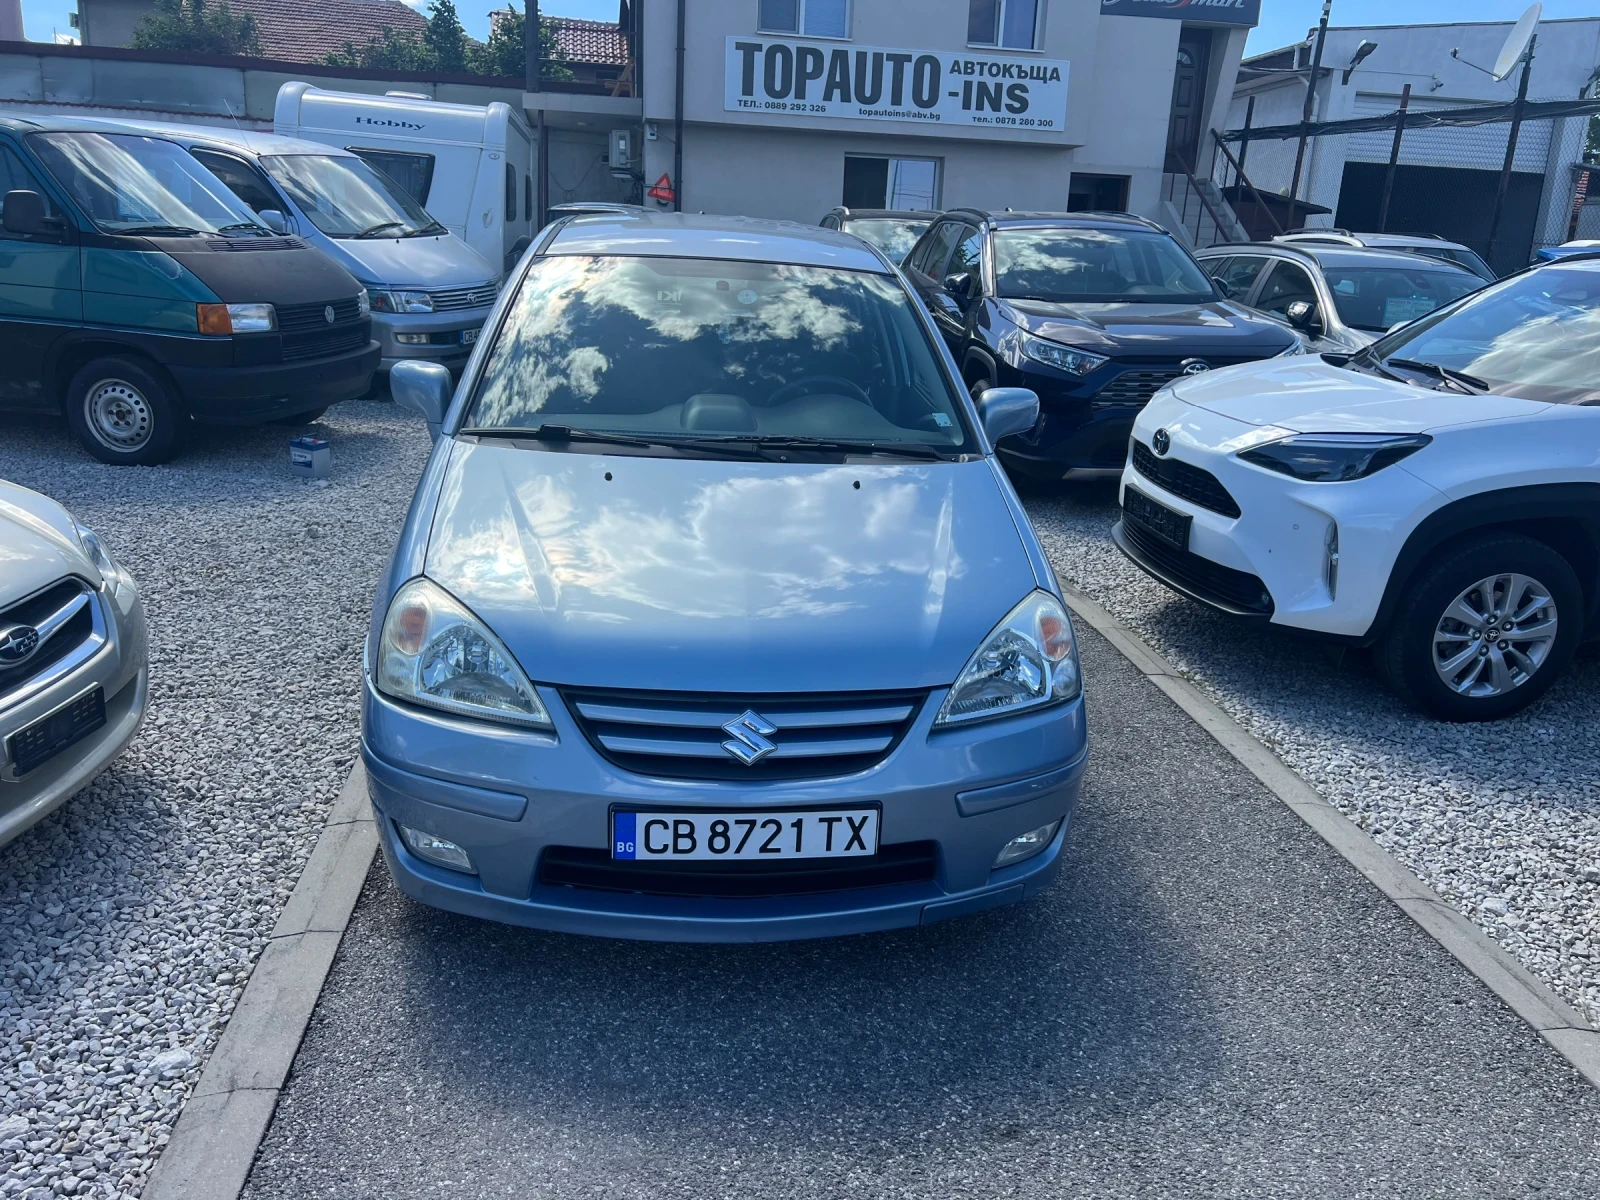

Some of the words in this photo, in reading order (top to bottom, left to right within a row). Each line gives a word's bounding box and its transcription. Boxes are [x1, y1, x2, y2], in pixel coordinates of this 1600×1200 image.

[735, 41, 941, 109] TOPAUTO
[948, 59, 1062, 84] АВТОКЪЩА
[947, 79, 1030, 115] -INS
[737, 99, 763, 109] ТЕЛ.:
[764, 101, 788, 111] 0889
[789, 103, 807, 112] 292
[809, 104, 827, 113] 326
[858, 107, 941, 121] topautoins@abv.bg
[972, 115, 994, 124] тел.:
[995, 116, 1017, 126] 0878
[1019, 117, 1036, 127] 280
[1037, 119, 1054, 128] 300
[355, 116, 426, 131] Hobby
[643, 818, 697, 855] CB
[707, 817, 804, 855] 8721
[818, 815, 870, 852] TX
[616, 841, 634, 853] BG
